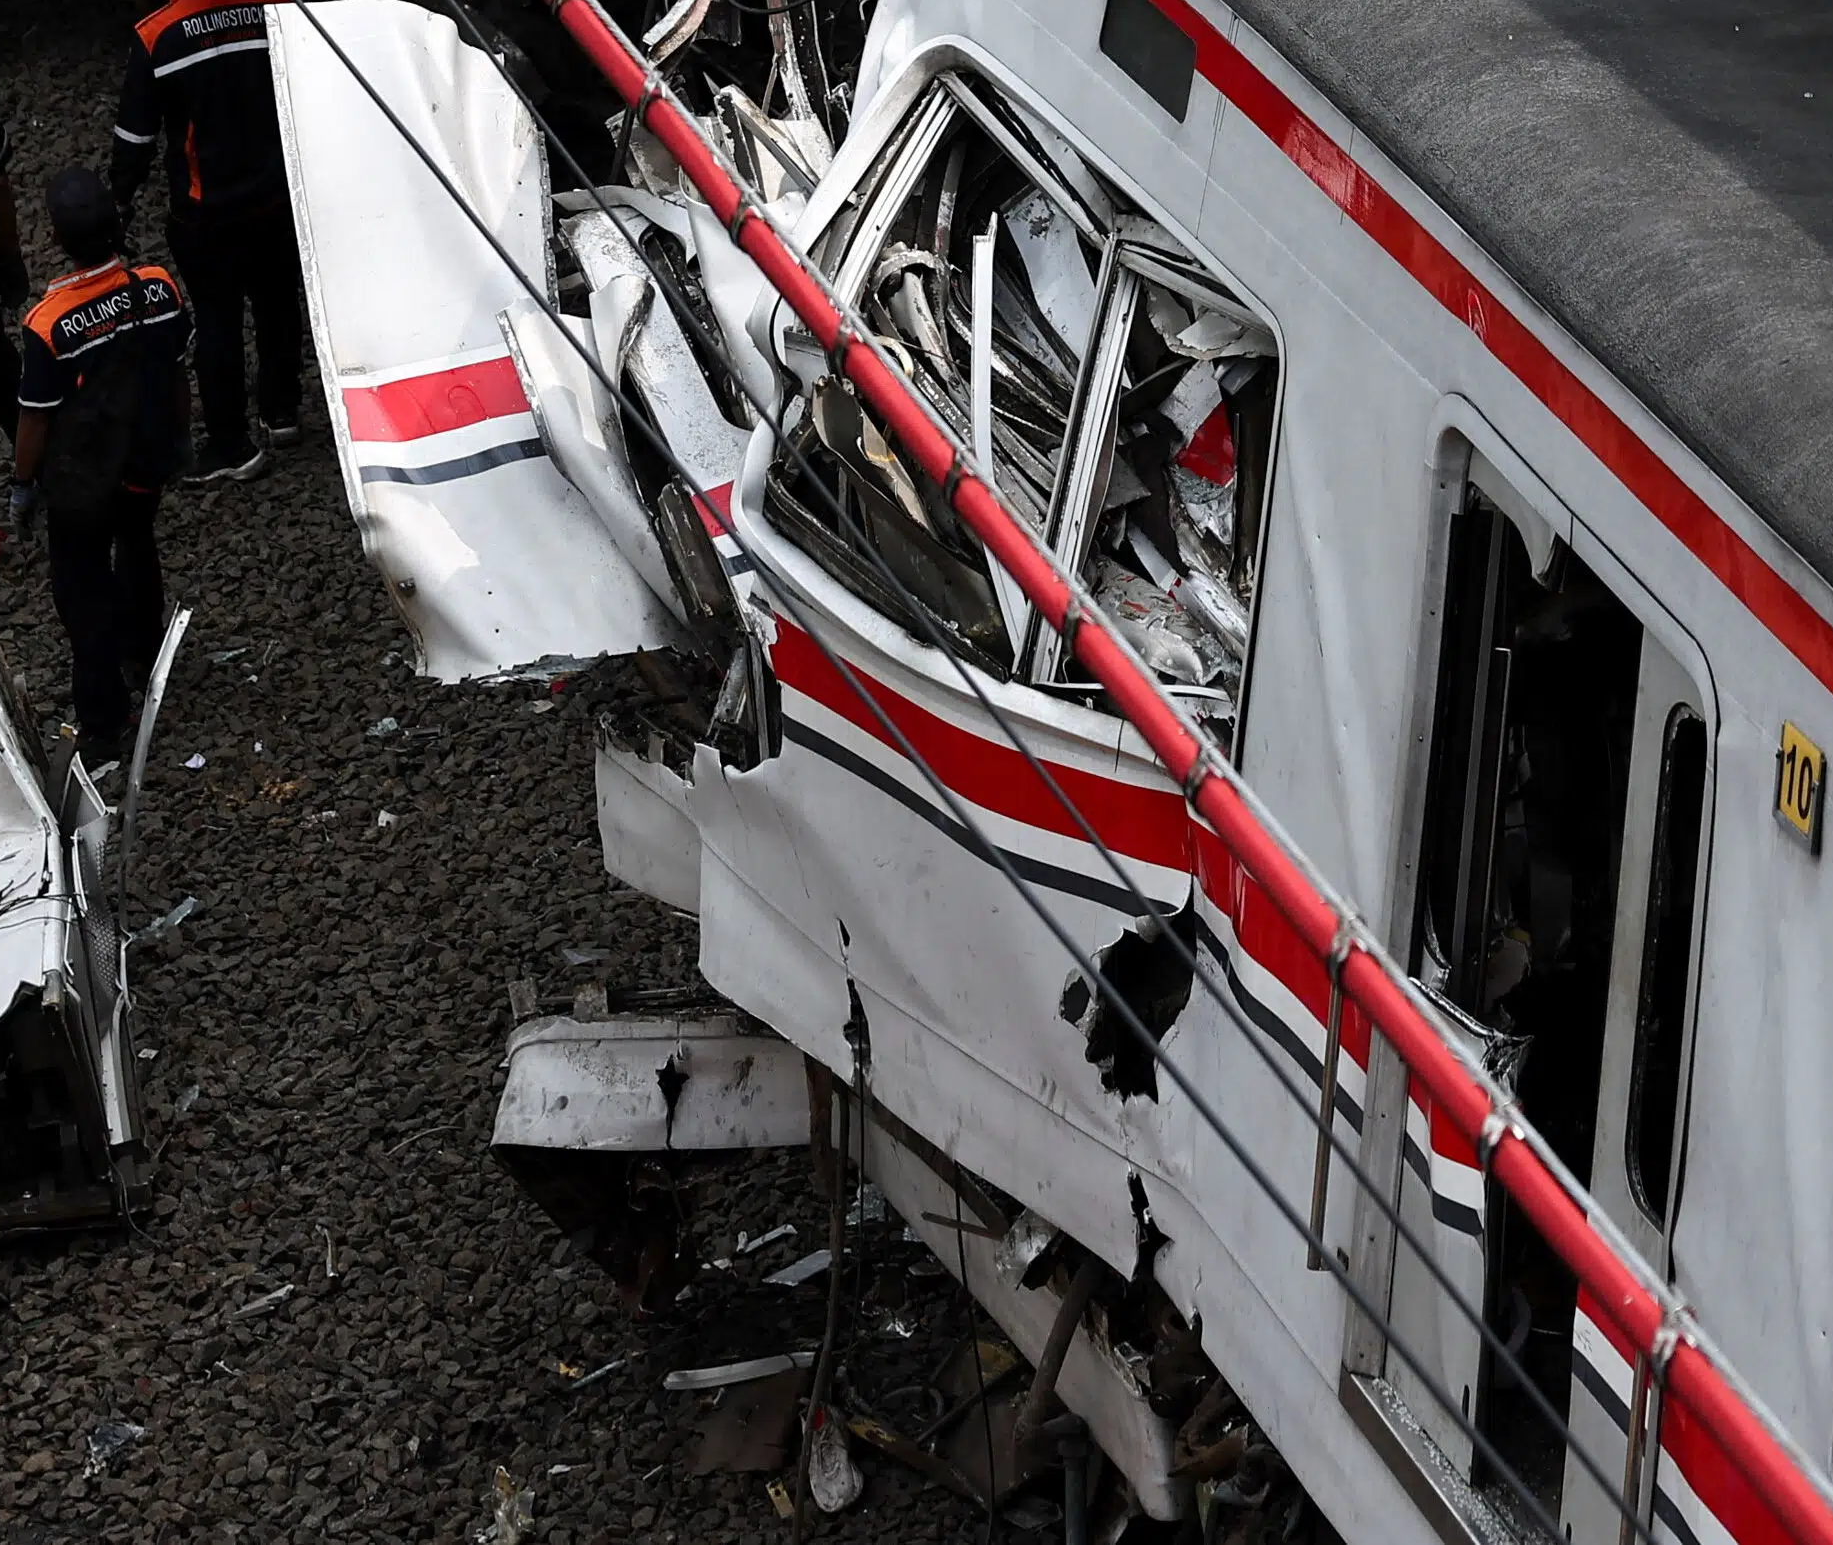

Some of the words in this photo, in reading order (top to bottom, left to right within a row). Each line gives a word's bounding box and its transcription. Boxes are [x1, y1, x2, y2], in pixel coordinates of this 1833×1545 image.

[182, 4, 266, 38] ROLLINGSTOCK
[60, 282, 170, 338] ROLLINGSCK
[1786, 744, 1813, 820] 10
